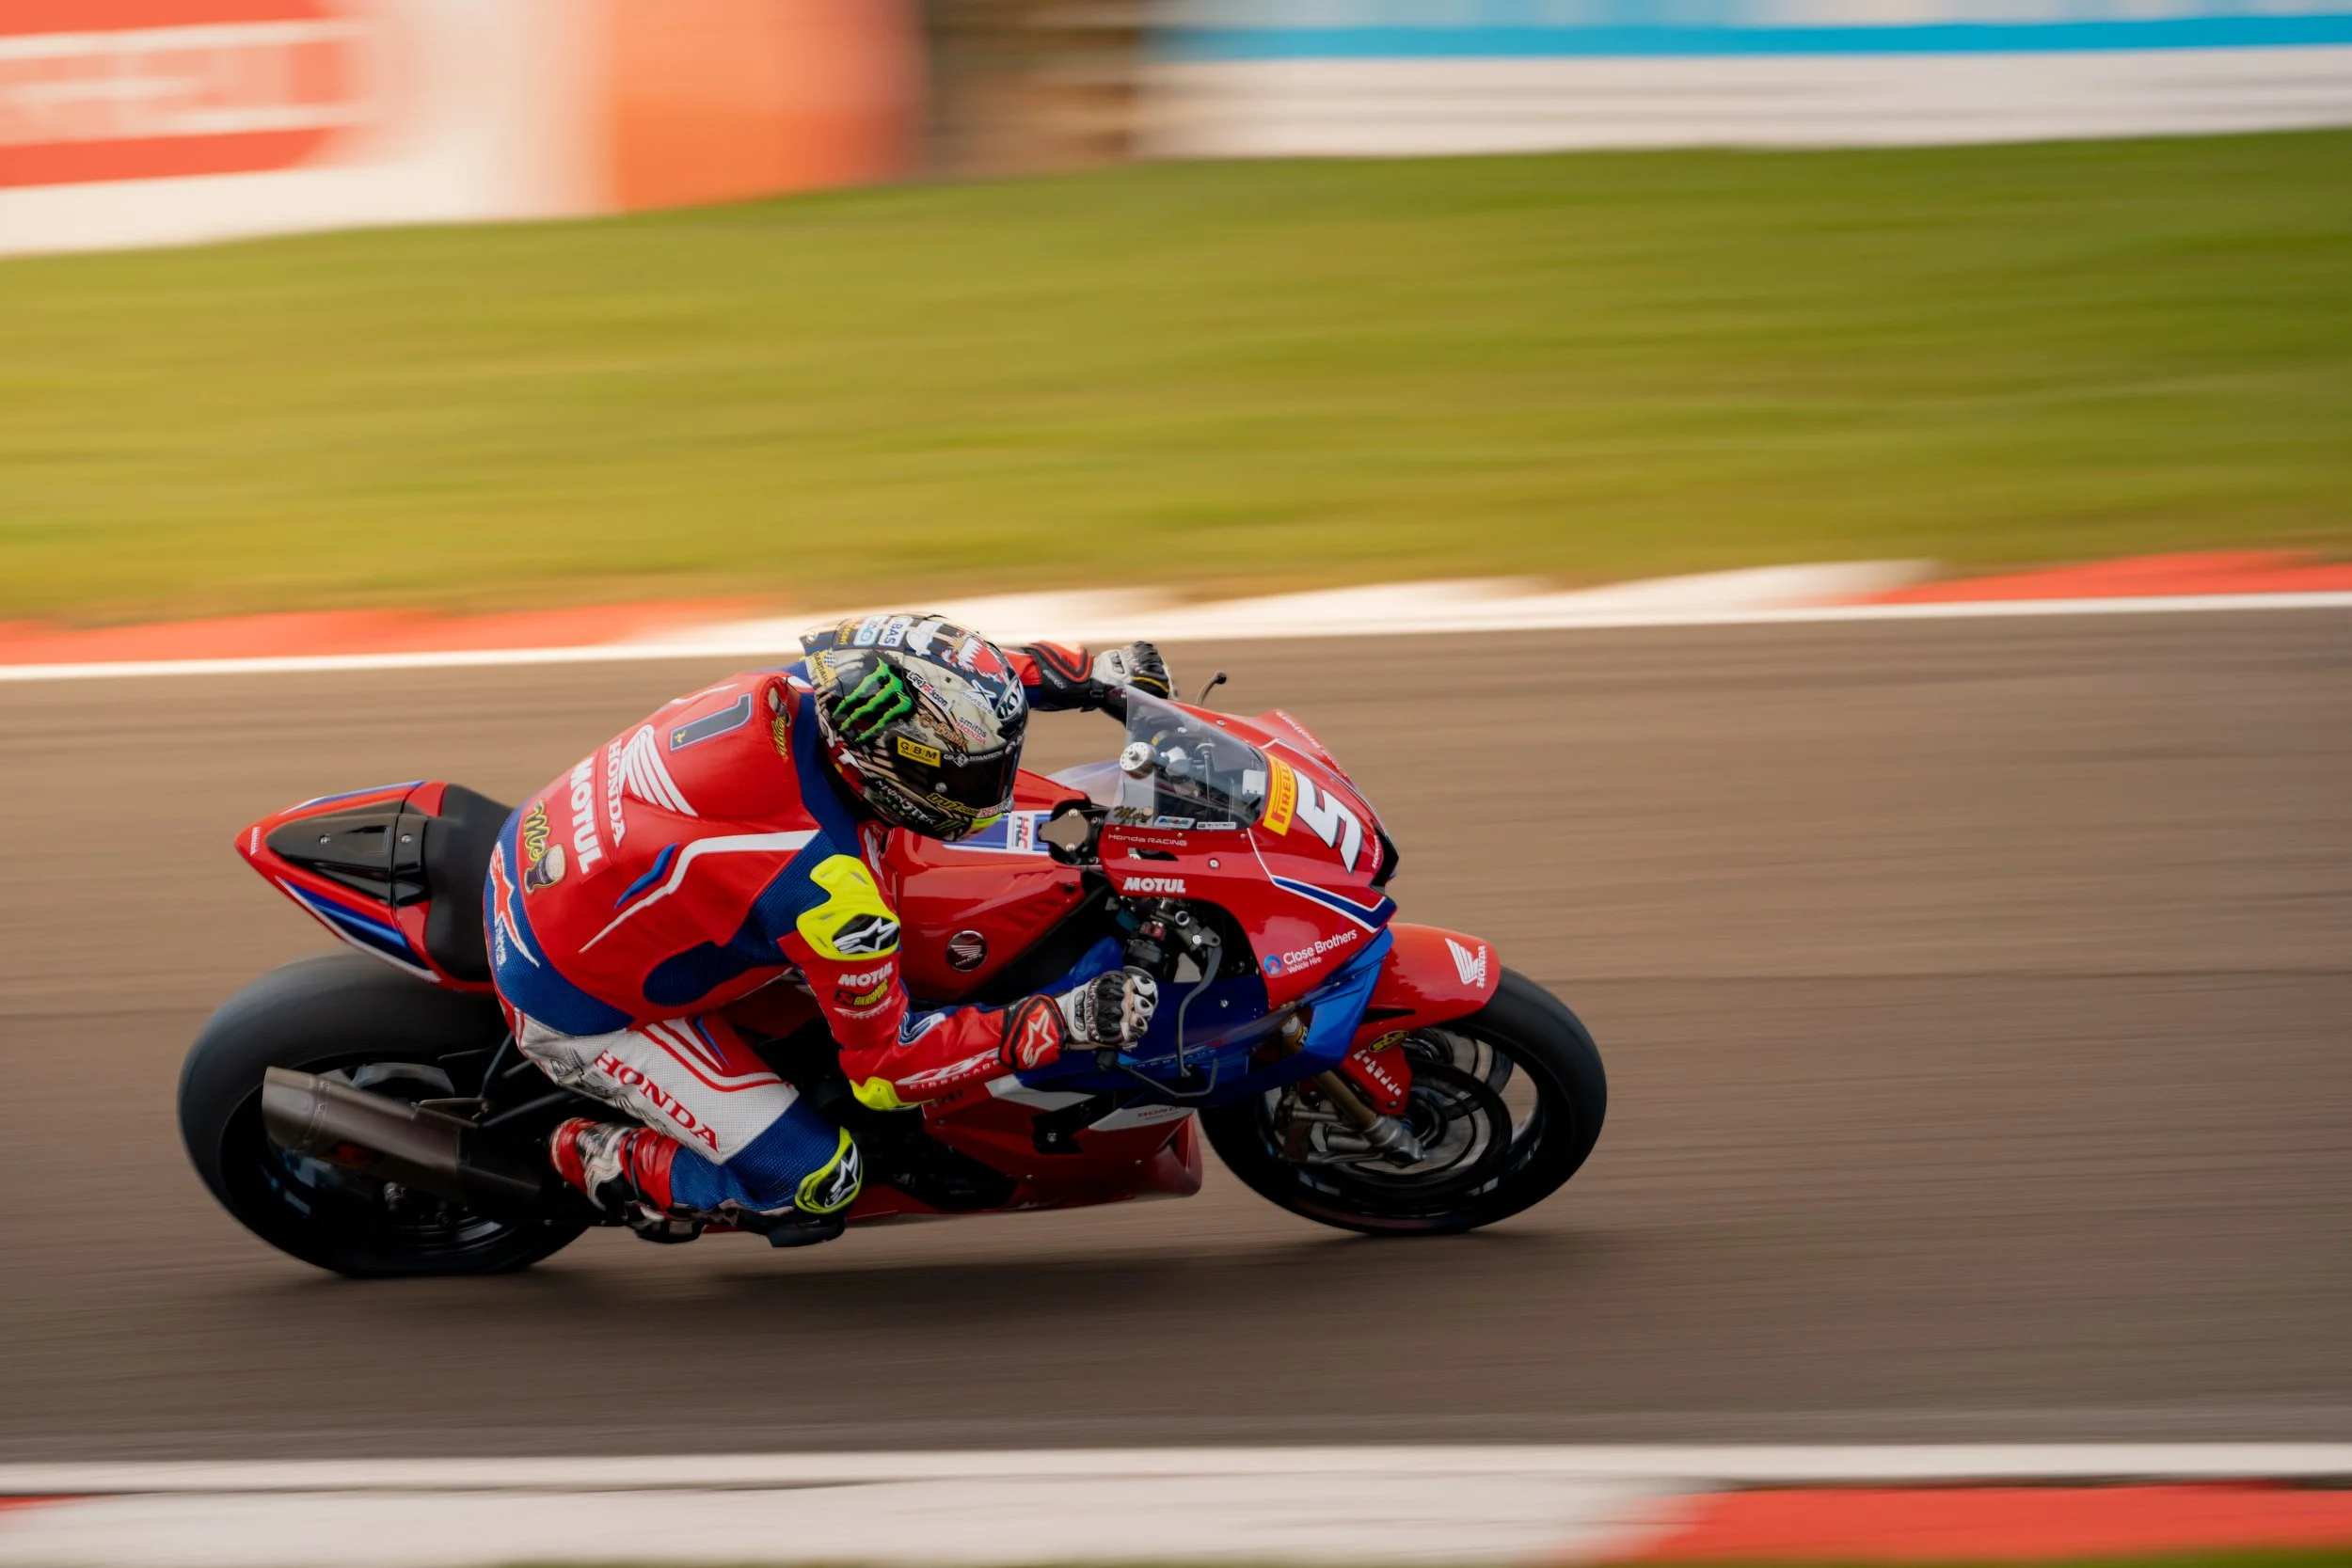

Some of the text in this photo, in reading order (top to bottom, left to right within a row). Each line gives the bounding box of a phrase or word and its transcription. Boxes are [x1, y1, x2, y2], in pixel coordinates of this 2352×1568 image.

[956, 721, 987, 746] HONDA
[959, 717, 988, 738] smiths
[608, 737, 628, 848] HONDA
[875, 780, 937, 825] MONSTER
[570, 755, 603, 875] MOTUL
[1293, 768, 1363, 876] 5
[1108, 833, 1187, 847] Honda RACING
[1122, 876, 1186, 895] MOTUL
[1282, 929, 1358, 966] Close Brothers
[838, 961, 893, 987] MOTUL
[1286, 960, 1309, 974] Vehicle
[1476, 945, 1486, 989] HONDA
[594, 1050, 720, 1153] HONDA
